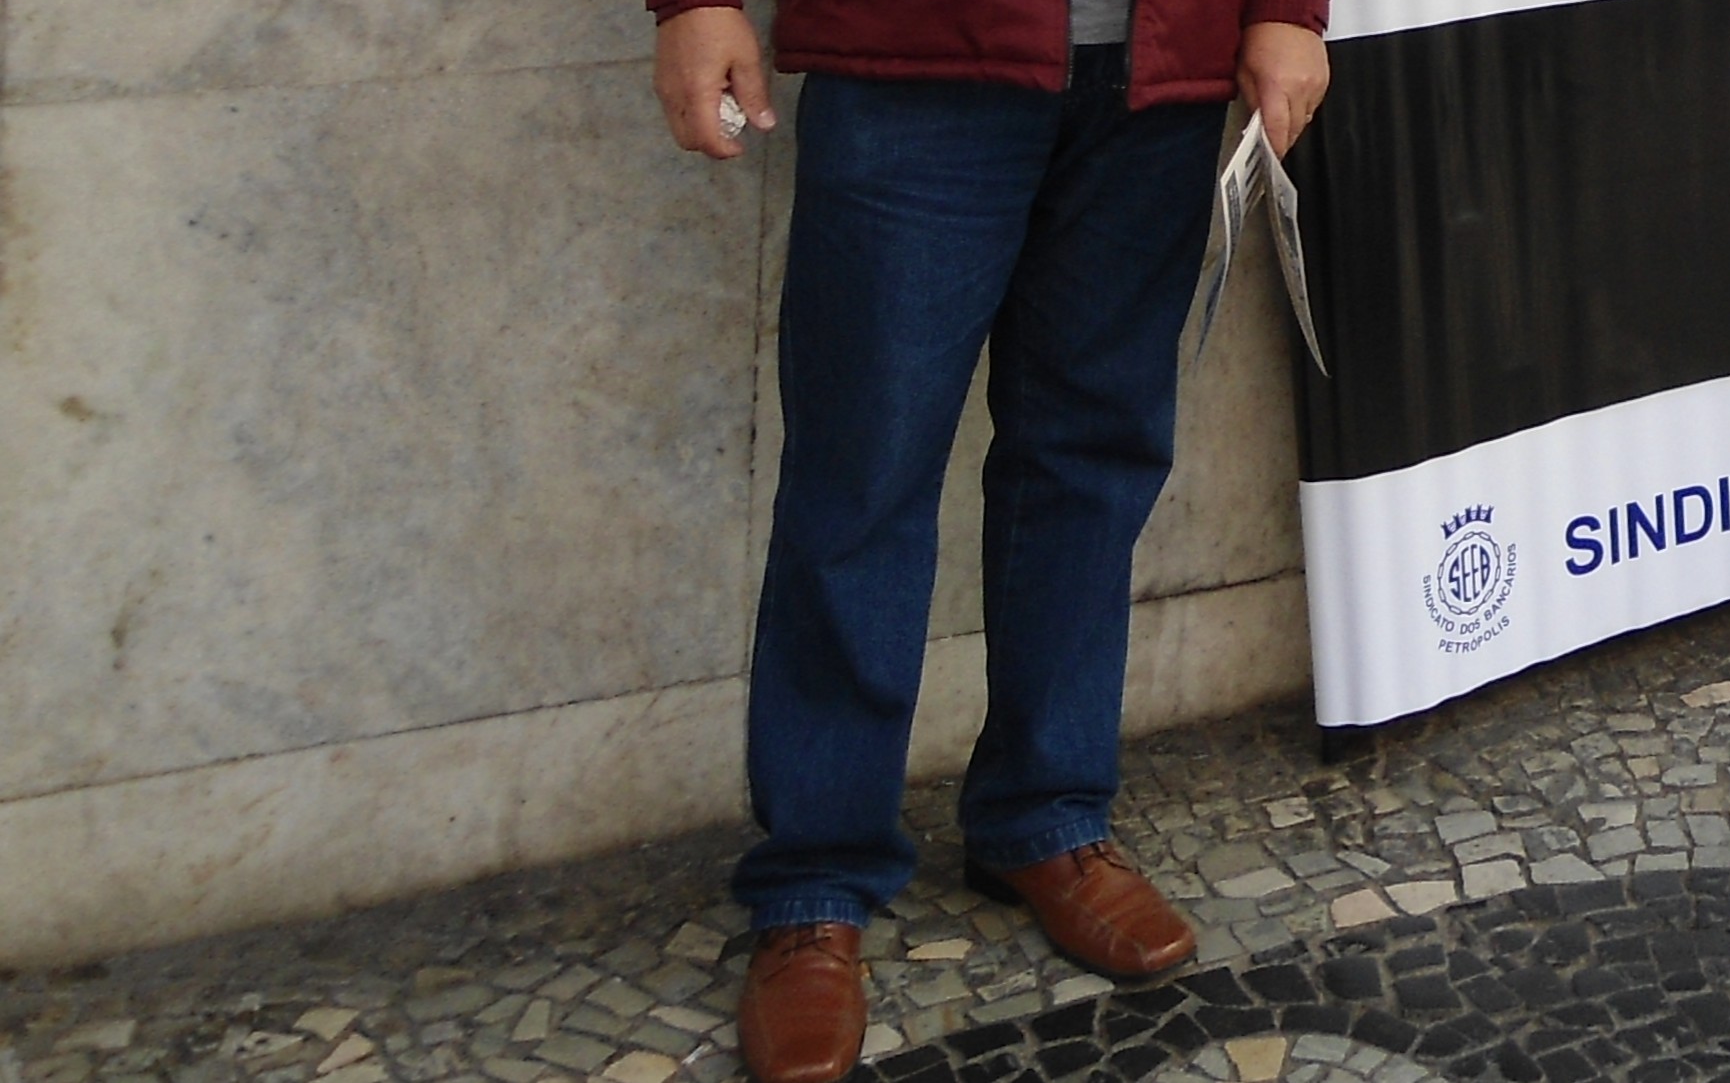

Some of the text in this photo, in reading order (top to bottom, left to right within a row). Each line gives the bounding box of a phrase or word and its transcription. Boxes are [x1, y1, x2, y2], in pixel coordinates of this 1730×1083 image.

[1423, 543, 1516, 635] SINDICATO DOS BANCÁRIOS
[1449, 543, 1490, 603] SEEB
[1438, 615, 1510, 654] PETRÓPOLIS
